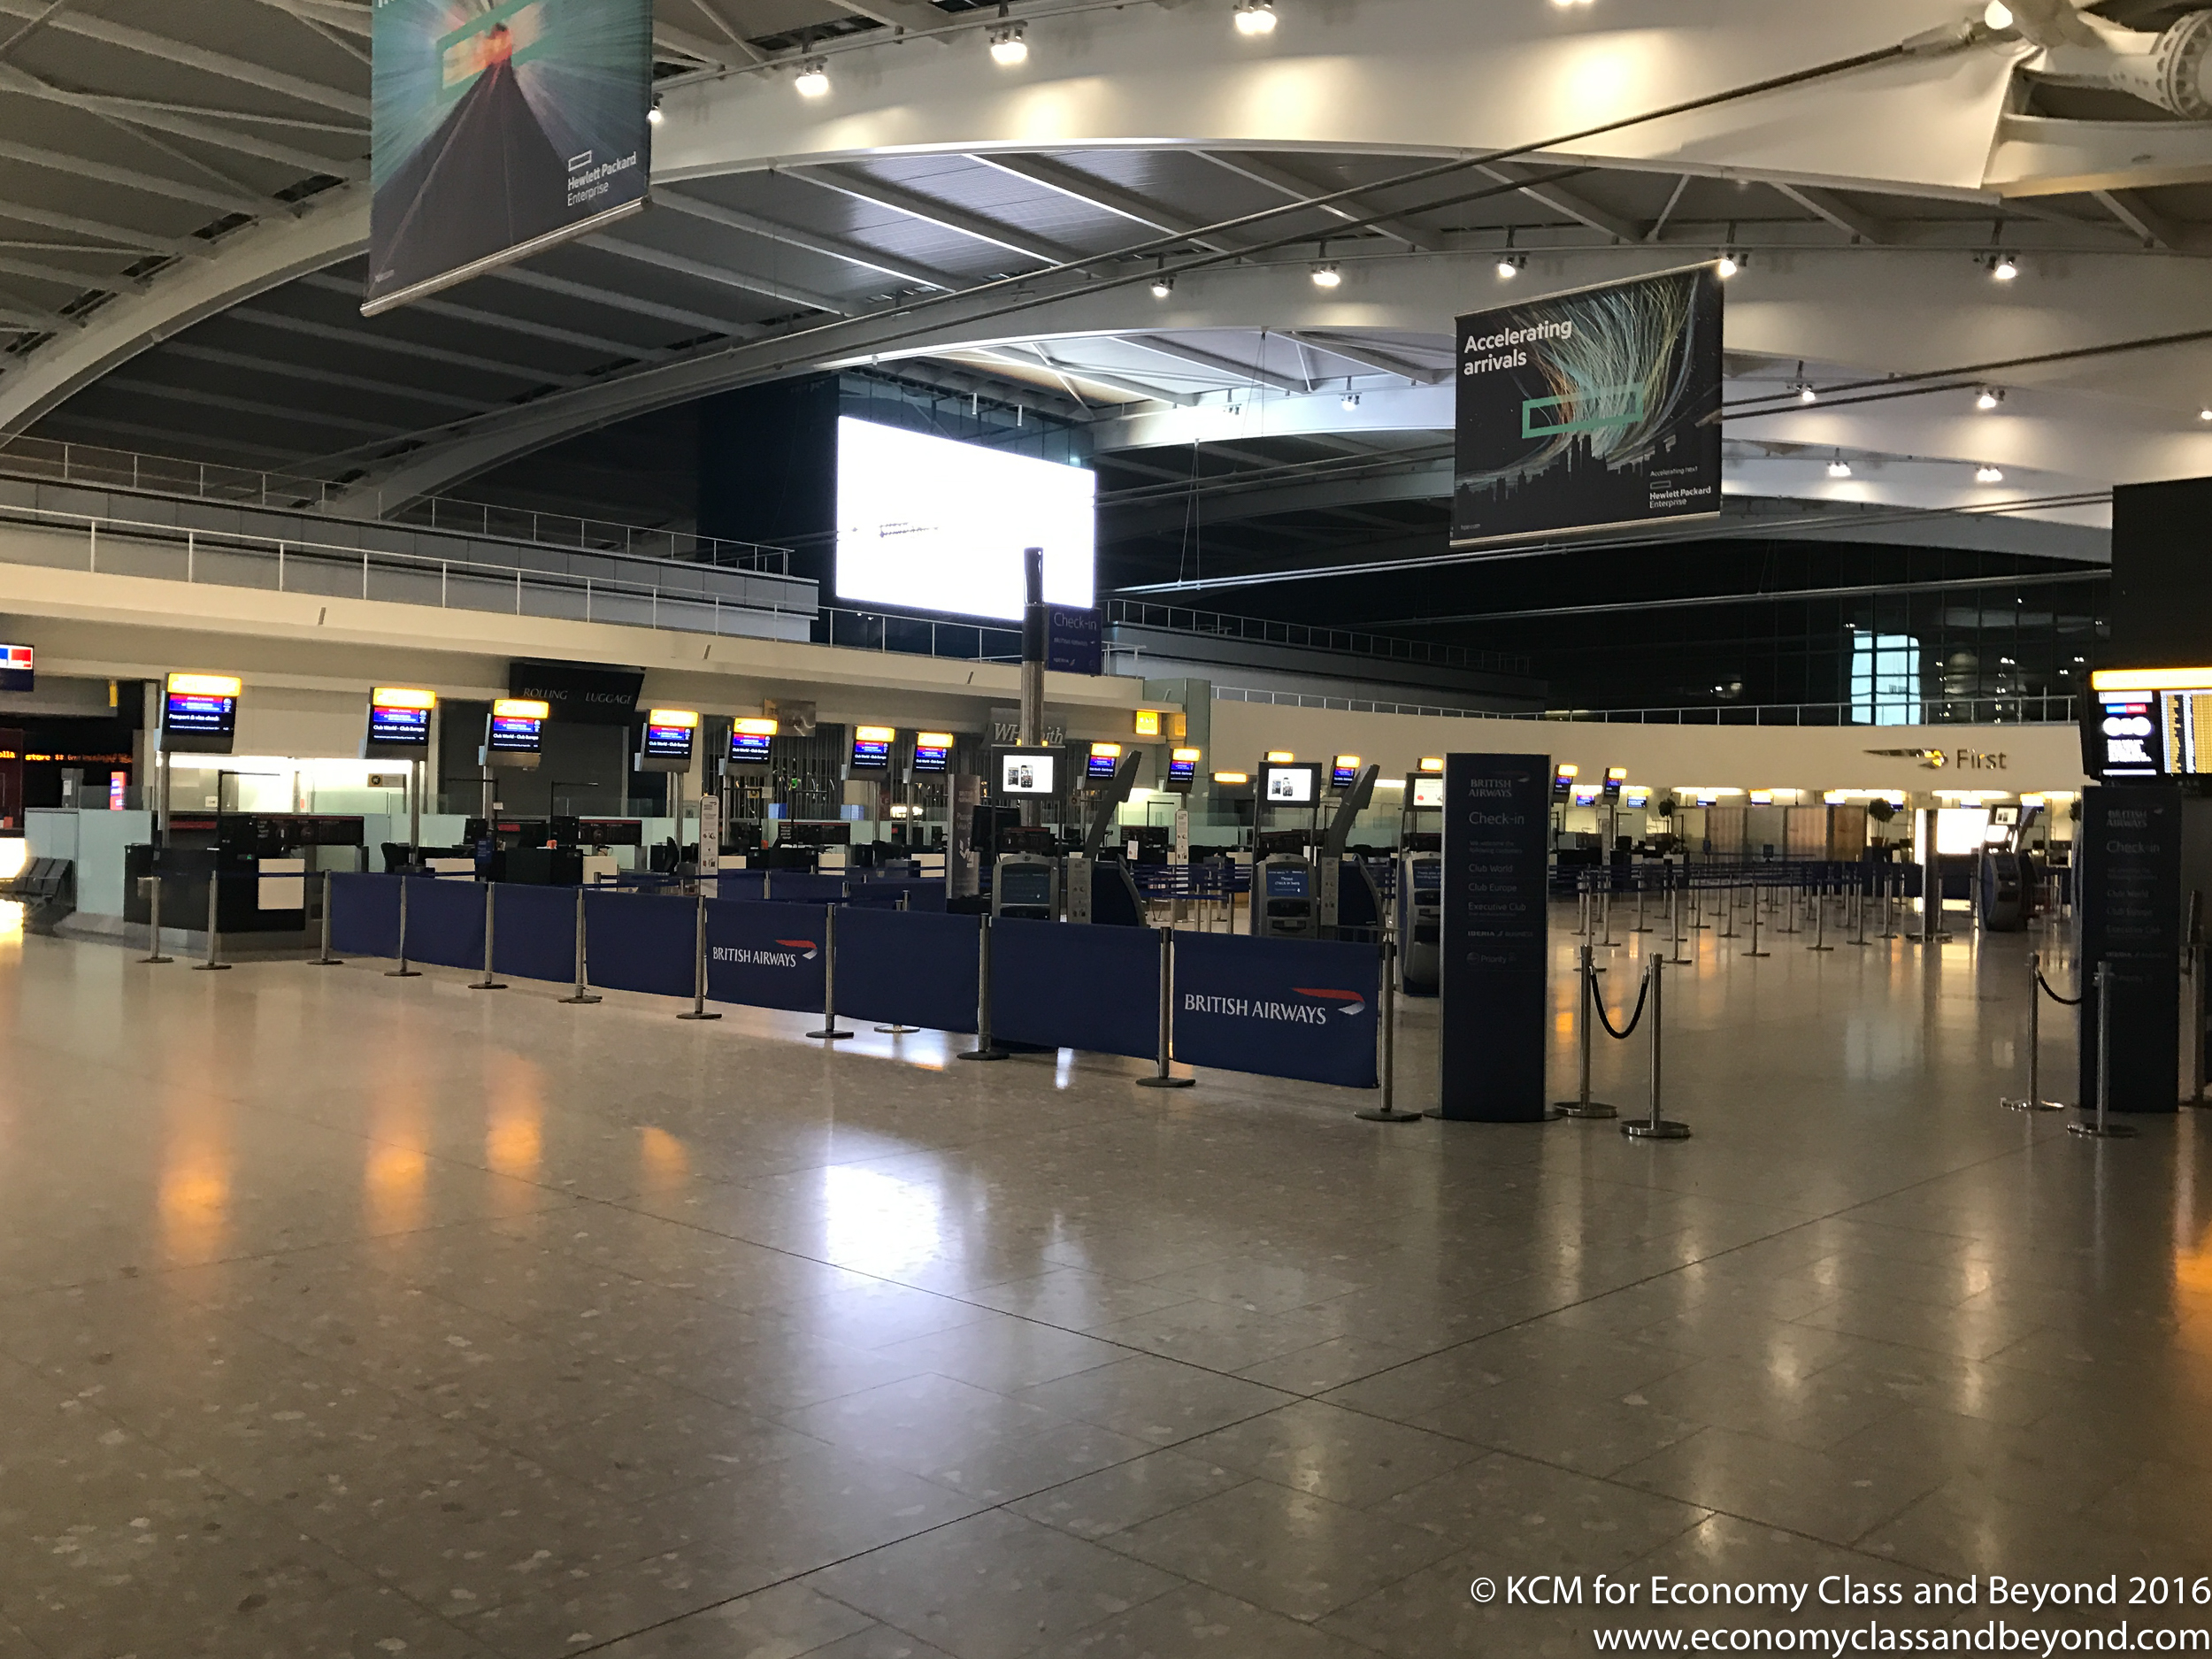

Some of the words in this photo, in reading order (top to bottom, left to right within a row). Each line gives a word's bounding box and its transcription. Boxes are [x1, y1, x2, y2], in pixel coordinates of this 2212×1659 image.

[568, 167, 601, 191] Hewlett
[602, 150, 637, 177] Packard
[567, 181, 609, 207] Enterprise
[1463, 319, 1572, 354] Accelerating
[1463, 348, 1527, 376] arrivals
[1649, 468, 1685, 477] Accelerating
[1649, 489, 1679, 500] Hewlett
[1680, 485, 1711, 497] Packard
[1649, 498, 1687, 509] Enterprise
[1054, 611, 1097, 631] Check-in
[523, 687, 568, 700] ROLLING
[585, 692, 632, 704] LUGGAGE
[25, 753, 51, 762] store
[1956, 748, 2008, 770] First
[1471, 779, 1511, 788] BRITISH
[1468, 788, 1512, 797] AIRWAYS
[1469, 811, 1525, 825] Check-in
[2108, 810, 2148, 819] BRITISH
[1468, 864, 1487, 872] Club
[1489, 883, 1517, 893] Europe
[1468, 902, 1507, 910] Executive
[1509, 902, 1526, 911] Club
[712, 946, 751, 964] BRITISH
[752, 950, 796, 968] AIRWAYS
[1481, 954, 1507, 964] Priority
[1185, 994, 1248, 1017] BRITISH
[1251, 1001, 1326, 1025] AIRWAYS
